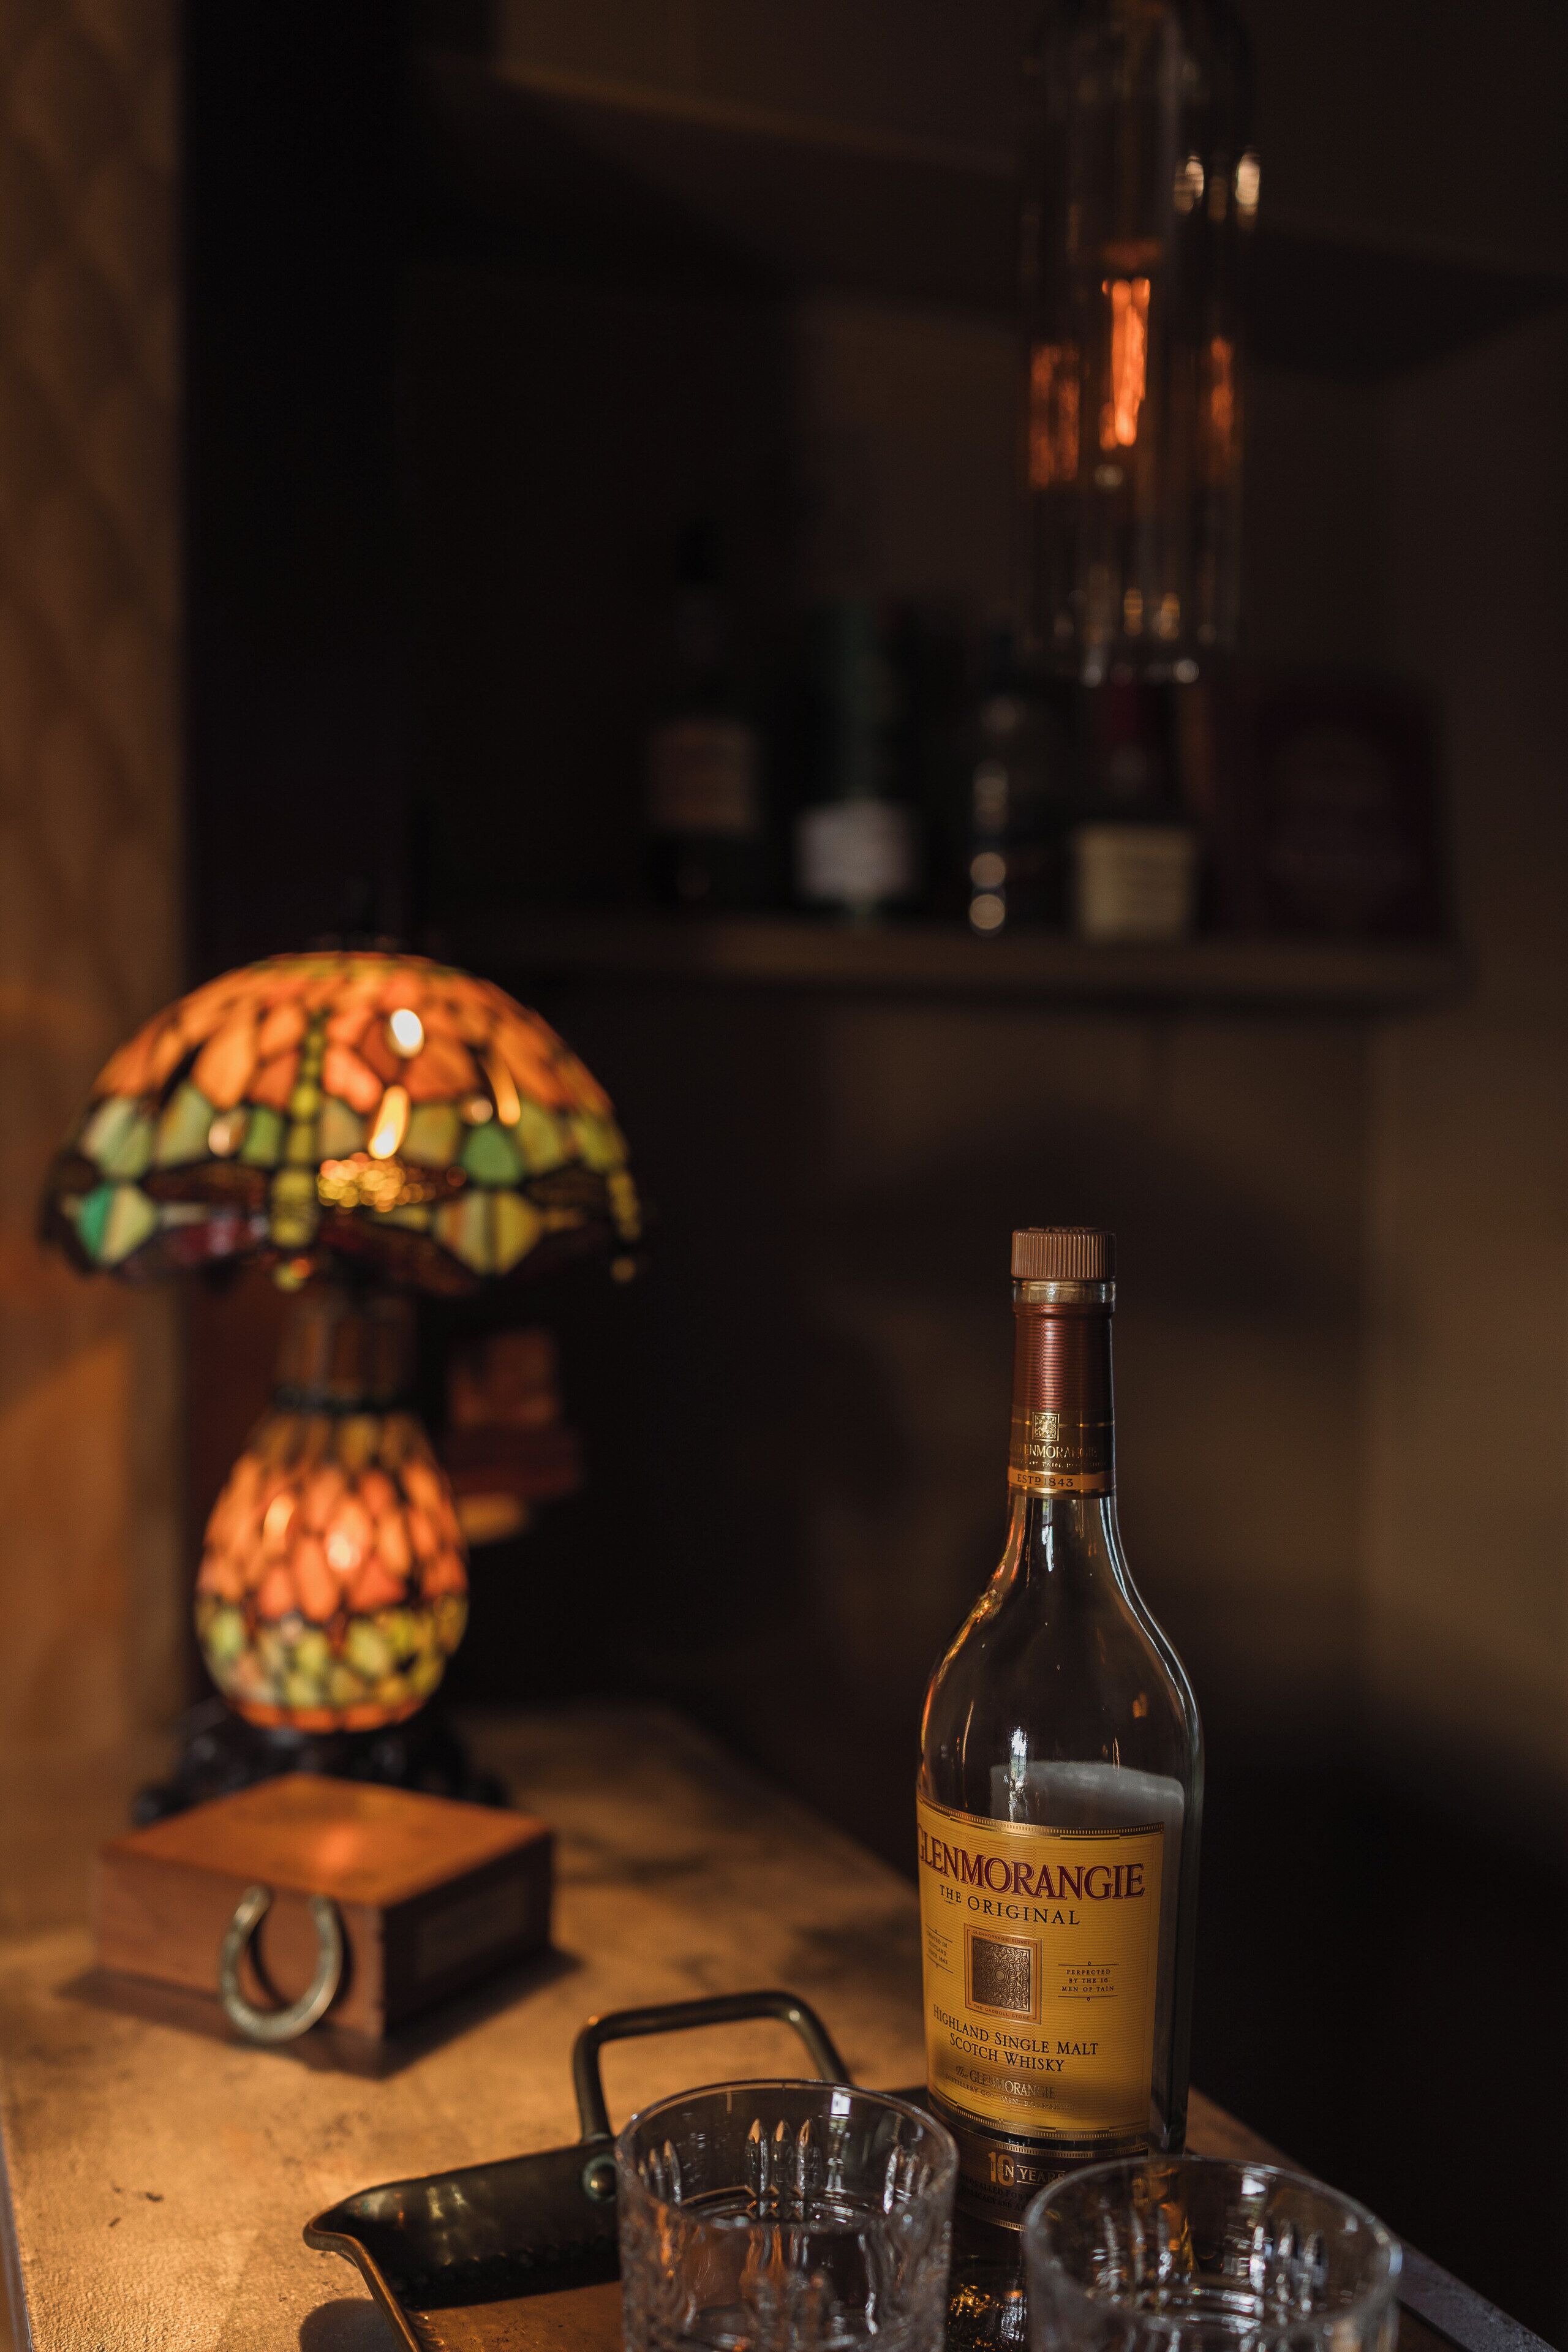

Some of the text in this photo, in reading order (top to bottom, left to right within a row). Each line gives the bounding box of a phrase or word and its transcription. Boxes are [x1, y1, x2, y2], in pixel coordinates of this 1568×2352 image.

[1014, 1442, 1098, 1459] ENMORANGIE
[1044, 1477, 1074, 1487] 1843
[940, 1884, 1080, 1924] THE ORIGINAL
[973, 1930, 1009, 1942] GLENMORANGIE
[985, 2006, 1009, 2017] CADBOLL
[933, 2004, 1098, 2055] HIGHLAND SINGLE MALT
[950, 2032, 1065, 2072] SCOTCH WHISKY
[945, 2073, 978, 2093] DISTILLERY
[956, 2065, 1057, 2099] The GLENMORANGIE
[988, 2151, 1015, 2187] 10
[959, 2173, 1003, 2196] NEQUALLED
